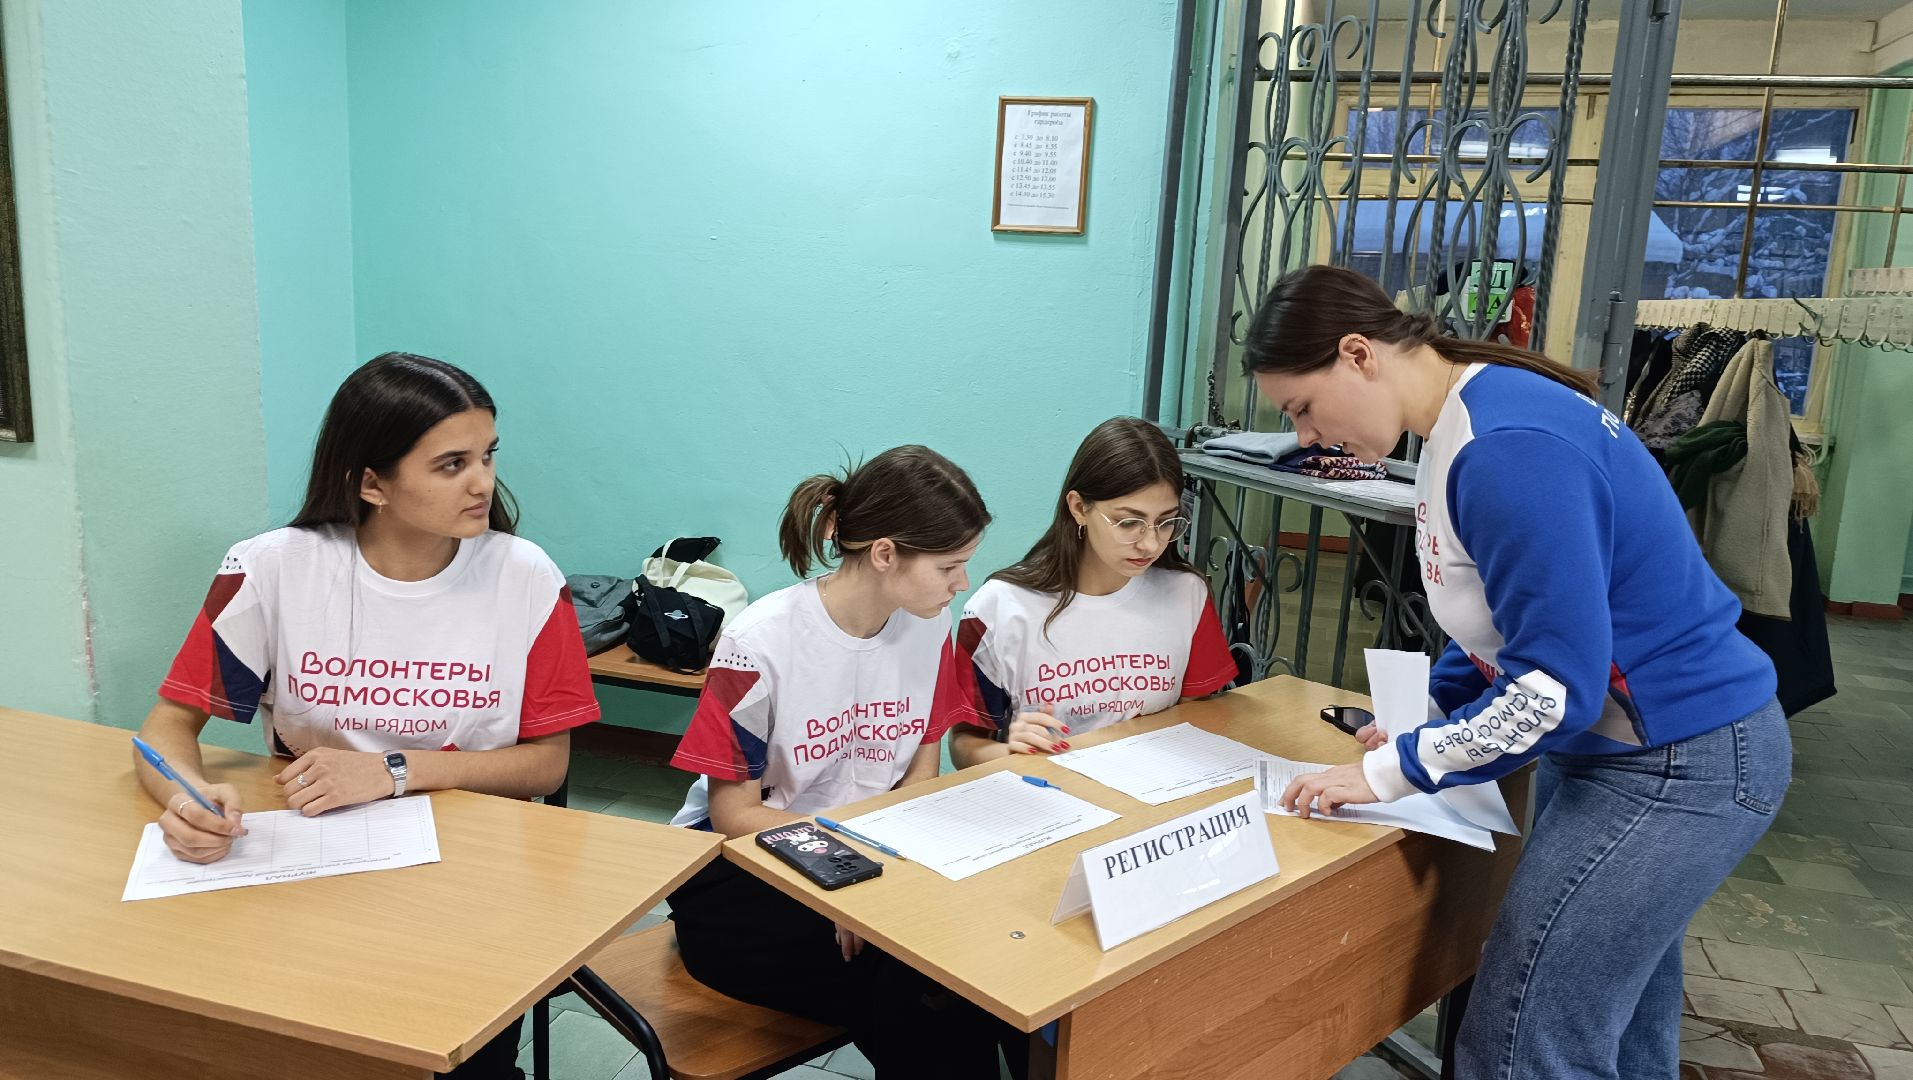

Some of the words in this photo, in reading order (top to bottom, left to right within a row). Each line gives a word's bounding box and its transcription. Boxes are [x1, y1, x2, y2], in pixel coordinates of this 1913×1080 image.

[300, 651, 491, 682] ВОЛОНТЕРЫ
[1038, 653, 1171, 682] ВОЛОНТЕРЫ
[288, 674, 501, 708] ПОДМОСКОВЬЯ
[1025, 675, 1176, 704] ПОДМОСКОВЬЯ
[1070, 703, 1095, 717] МЫ
[1098, 699, 1145, 713] РЯДОМ
[334, 717, 368, 731] МЫ
[375, 718, 447, 735] РЯДОМ
[1103, 804, 1251, 880] РЕГИСТРАЦИЯ
